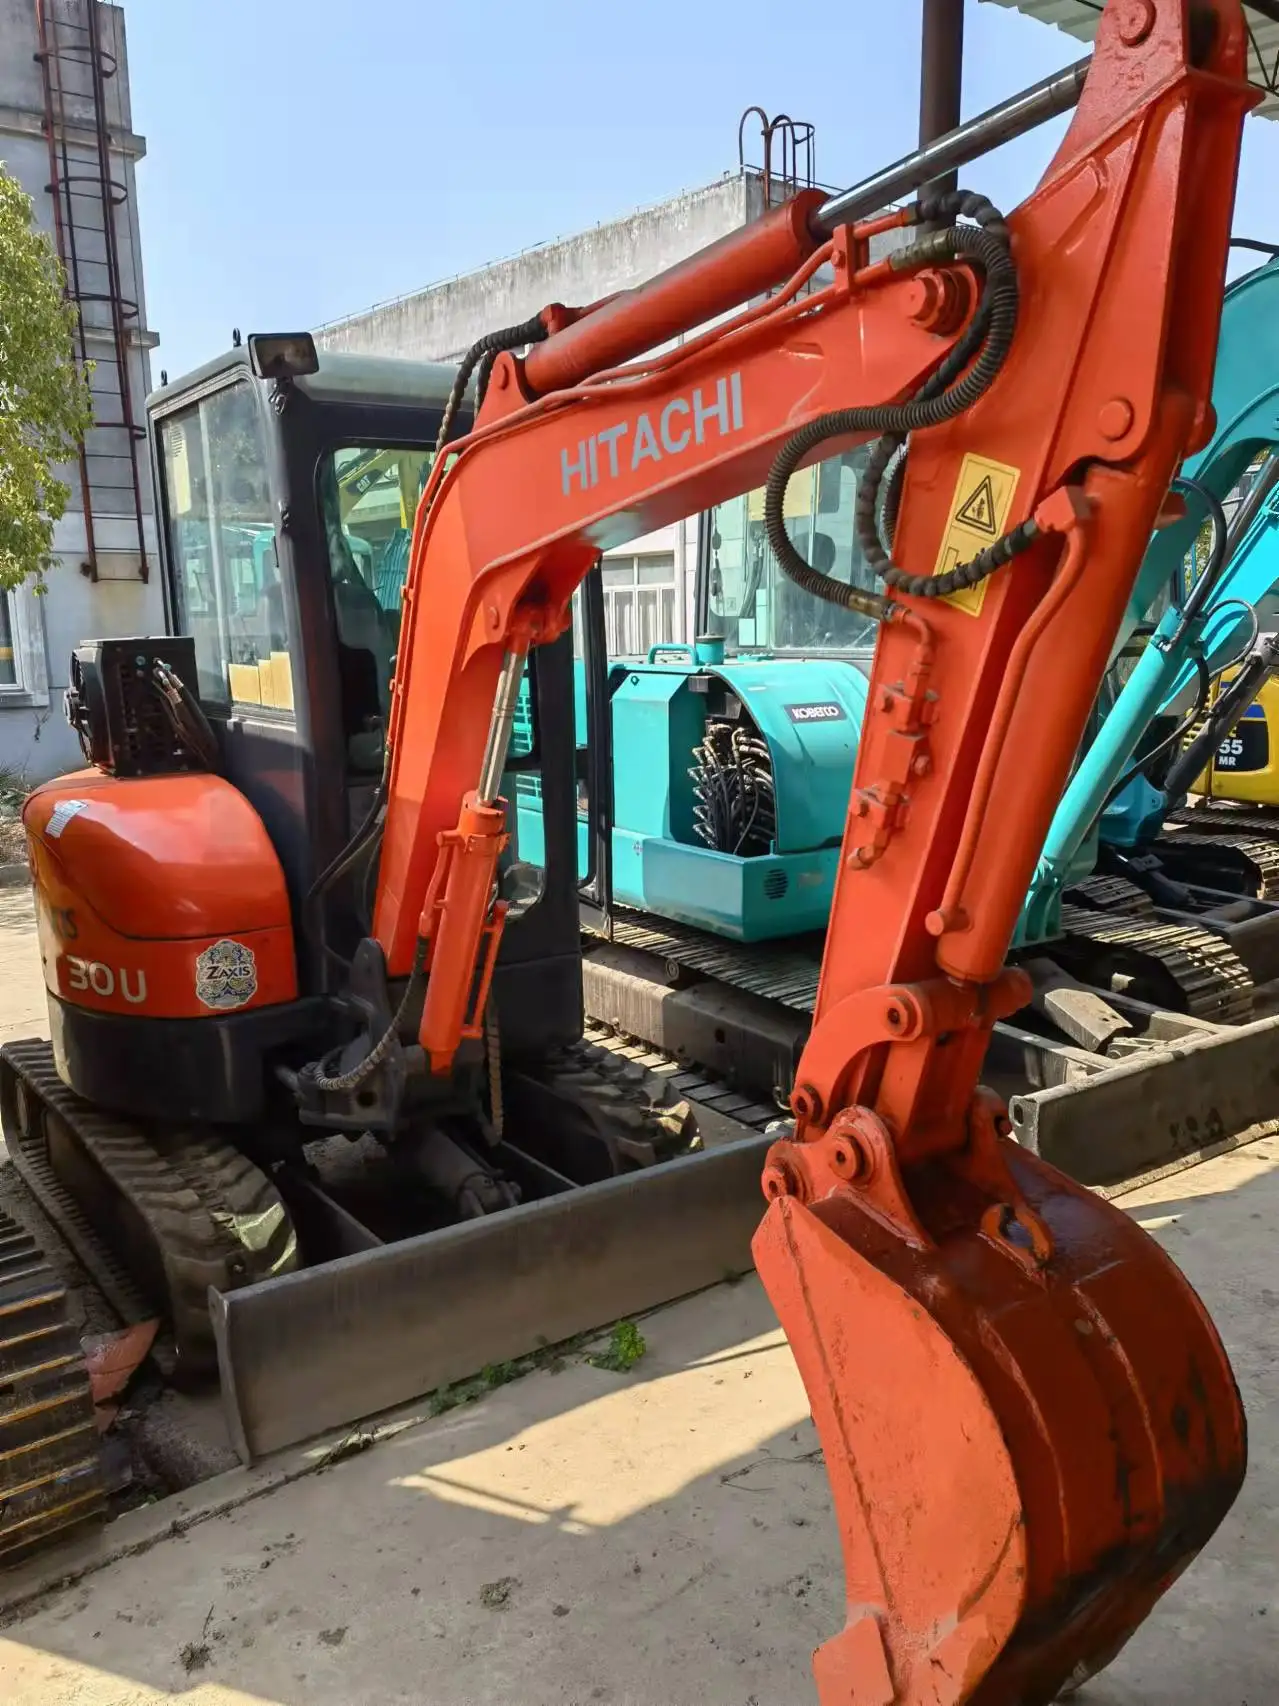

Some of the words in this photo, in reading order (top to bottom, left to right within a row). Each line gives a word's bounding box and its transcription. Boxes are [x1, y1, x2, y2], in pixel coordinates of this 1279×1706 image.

[560, 371, 744, 496] HITACHI
[791, 706, 839, 719] KOBELCO
[1218, 756, 1236, 766] MR
[67, 955, 147, 1003] 30U
[206, 966, 251, 980] ZAXIS
